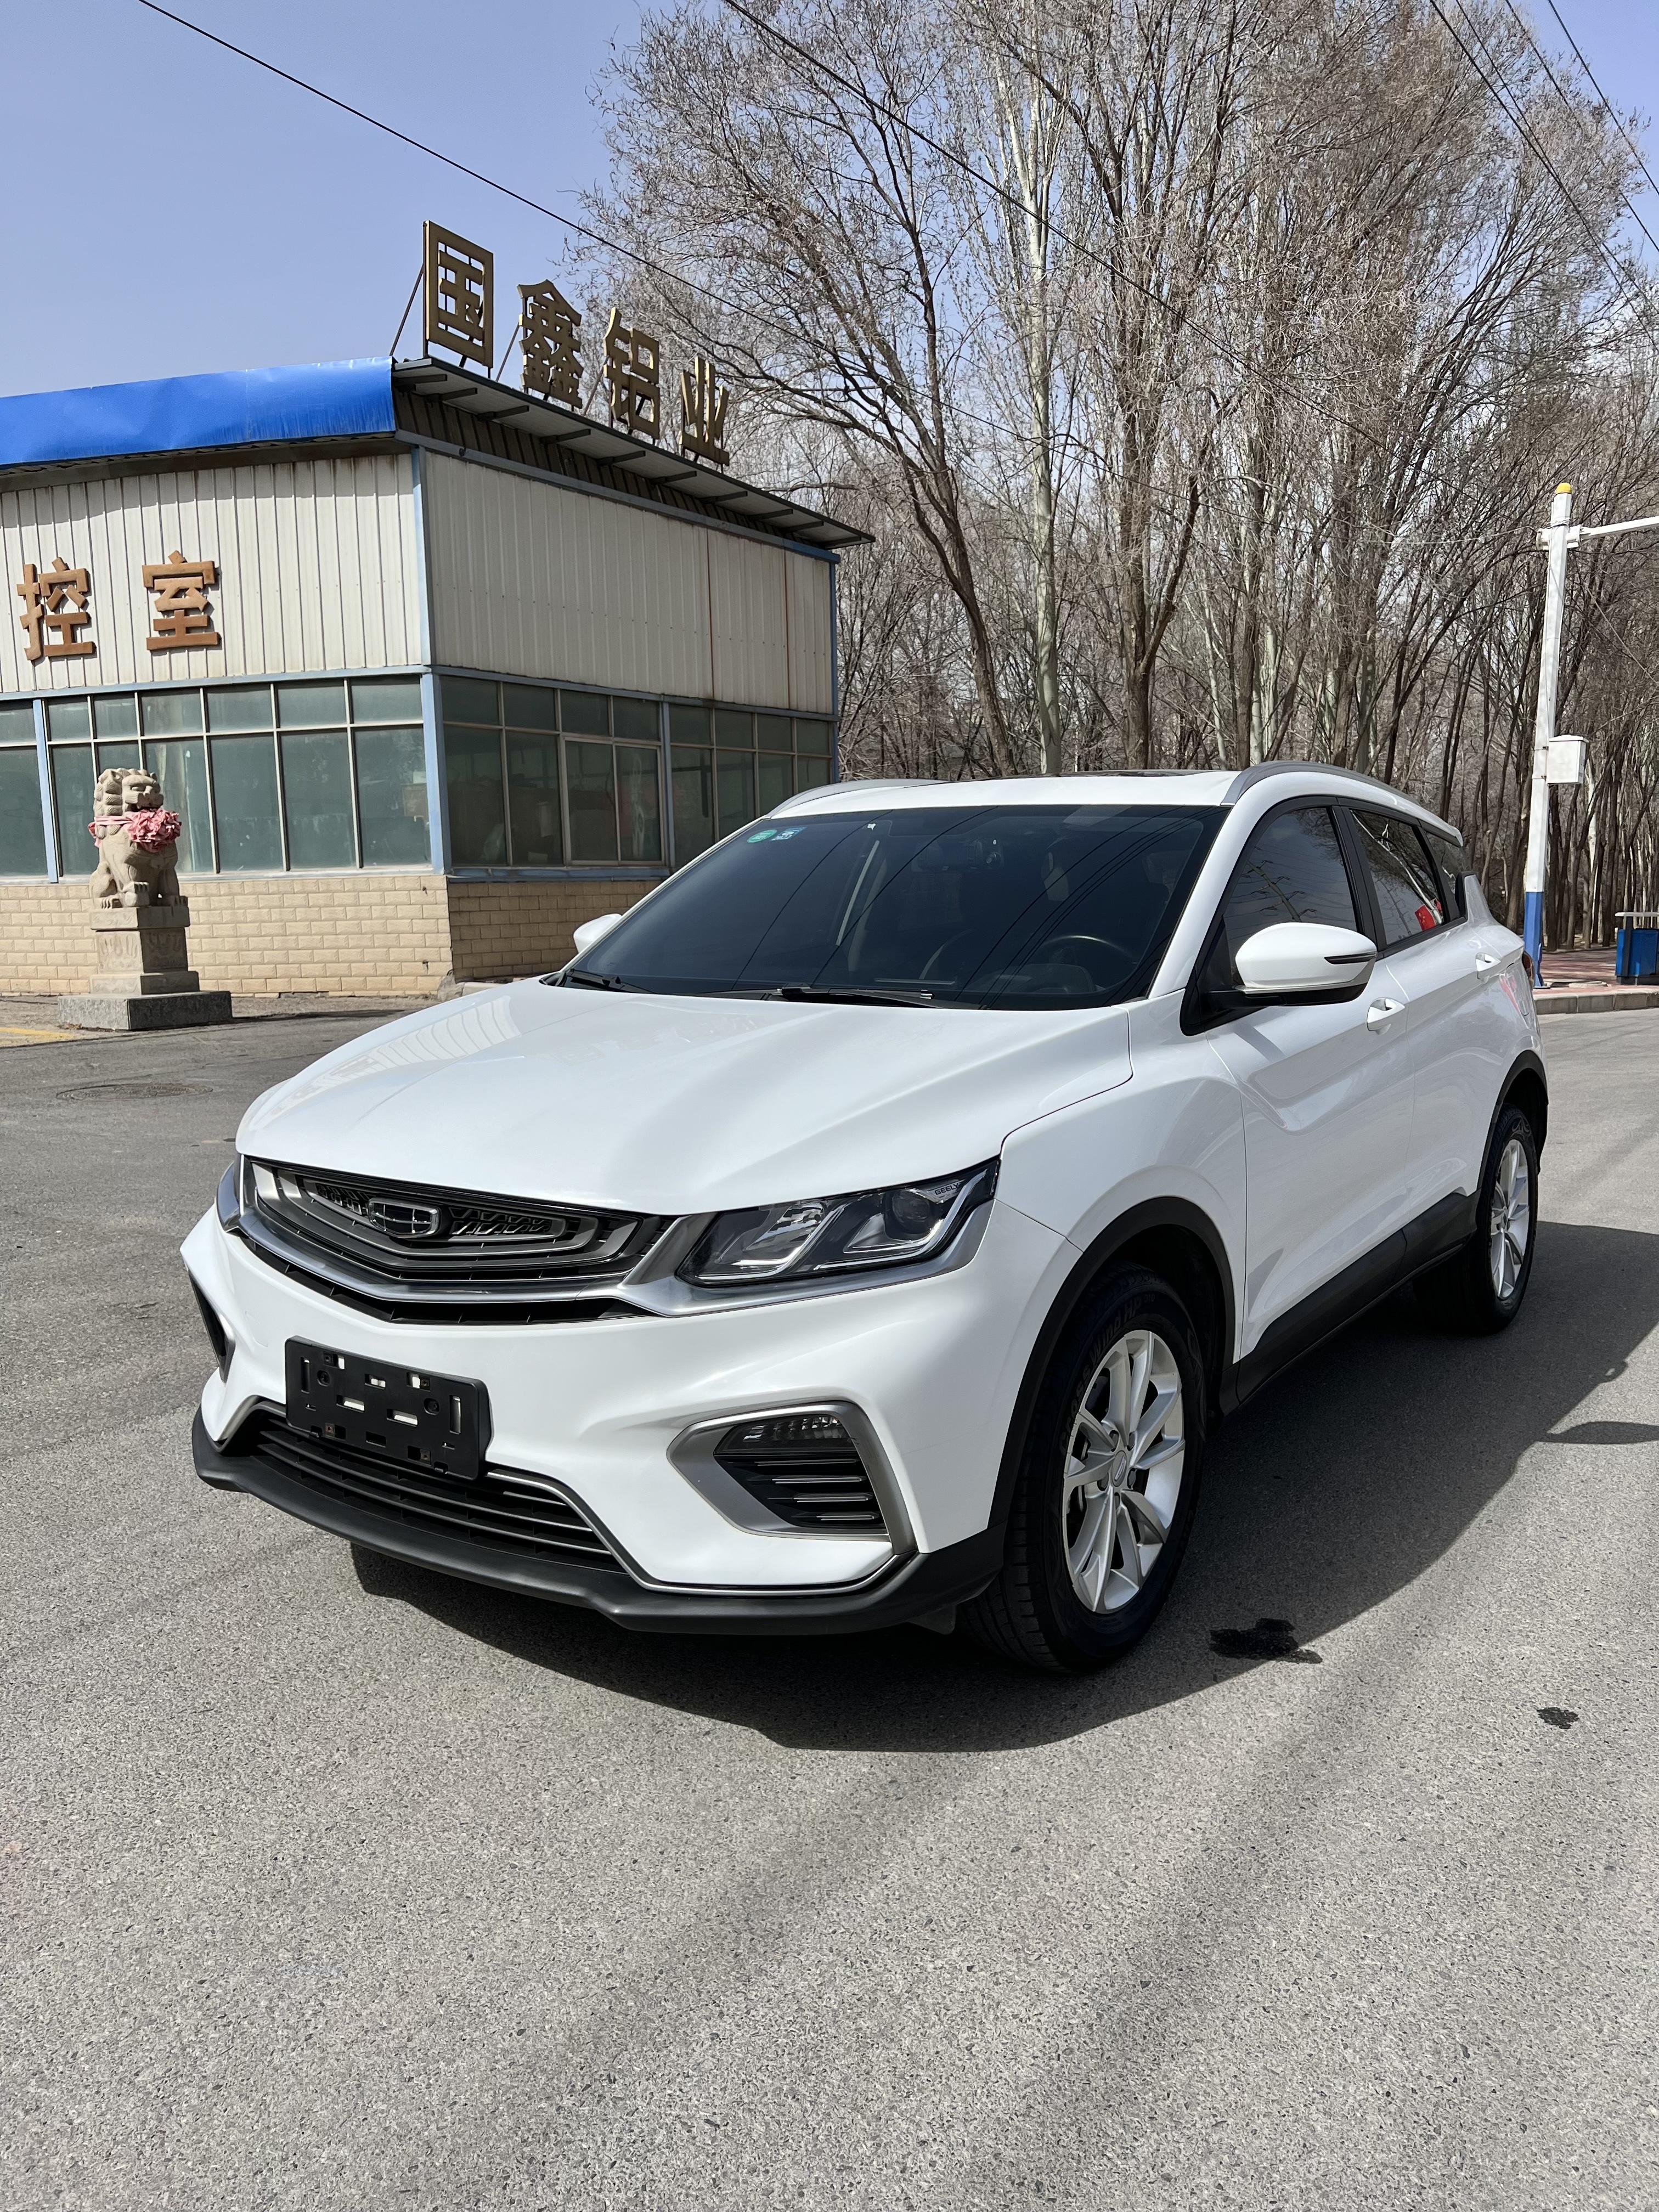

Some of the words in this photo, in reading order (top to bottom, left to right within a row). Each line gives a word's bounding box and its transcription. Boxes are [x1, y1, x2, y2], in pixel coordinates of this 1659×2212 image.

[425, 221, 730, 466] 国鑫铝业
[16, 550, 219, 660] 控室
[934, 1182, 959, 1195] GEELY
